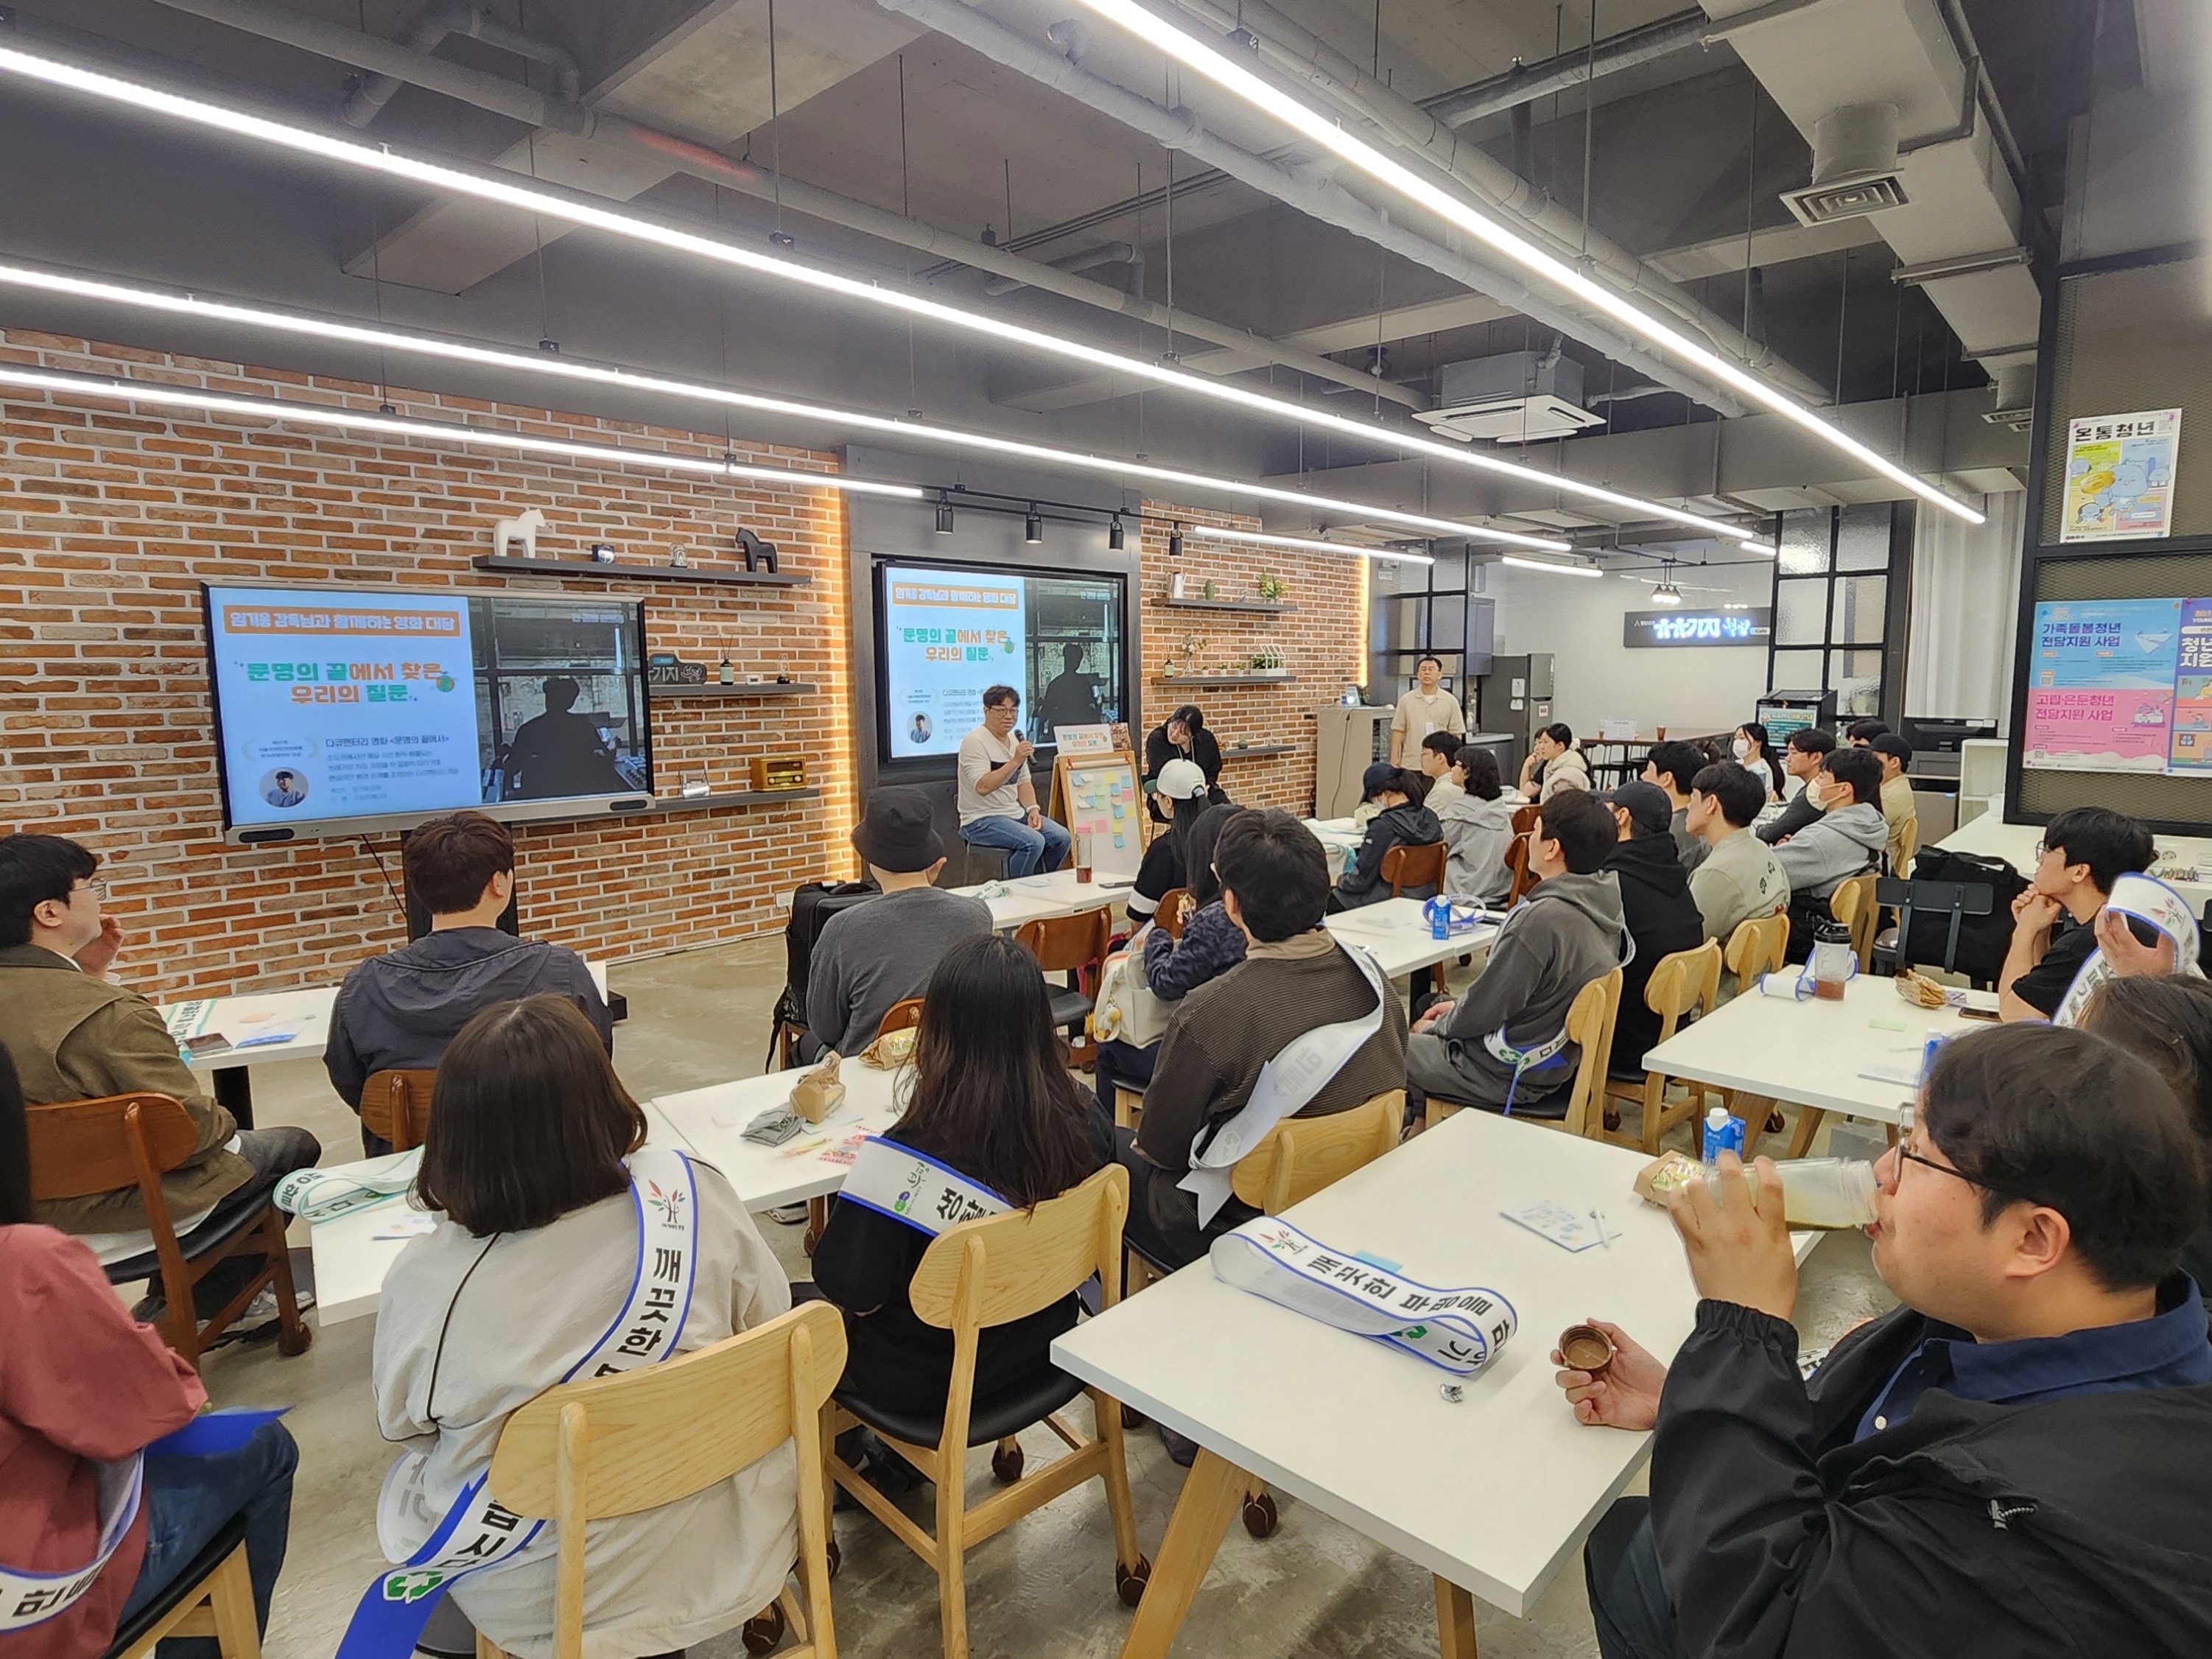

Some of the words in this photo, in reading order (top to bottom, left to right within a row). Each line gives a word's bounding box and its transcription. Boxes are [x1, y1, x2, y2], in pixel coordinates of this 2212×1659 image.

[2075, 421, 2155, 442] 온통청년
[273, 613, 331, 628] 감독님과
[334, 614, 392, 629] 함께하는
[394, 615, 423, 630] 영화
[426, 617, 454, 631] 대담
[2042, 622, 2121, 634] 가족돌봄청년
[903, 628, 941, 643] 문명의
[945, 628, 981, 644] 끝에서
[2041, 636, 2091, 648] 전담지원
[2094, 636, 2121, 647] 사업
[925, 647, 962, 662] 우리의
[966, 646, 989, 661] 질문
[247, 662, 319, 681] 문명의
[326, 662, 394, 681] 끝에서
[401, 662, 442, 680] 찾은
[291, 685, 360, 703] 우리의
[366, 684, 407, 702] 질문
[2035, 709, 2085, 720] 전담지원
[2088, 709, 2113, 721] 사업
[1306, 1255, 1398, 1300] 깨끗한
[625, 1247, 681, 1358] 깨끗한
